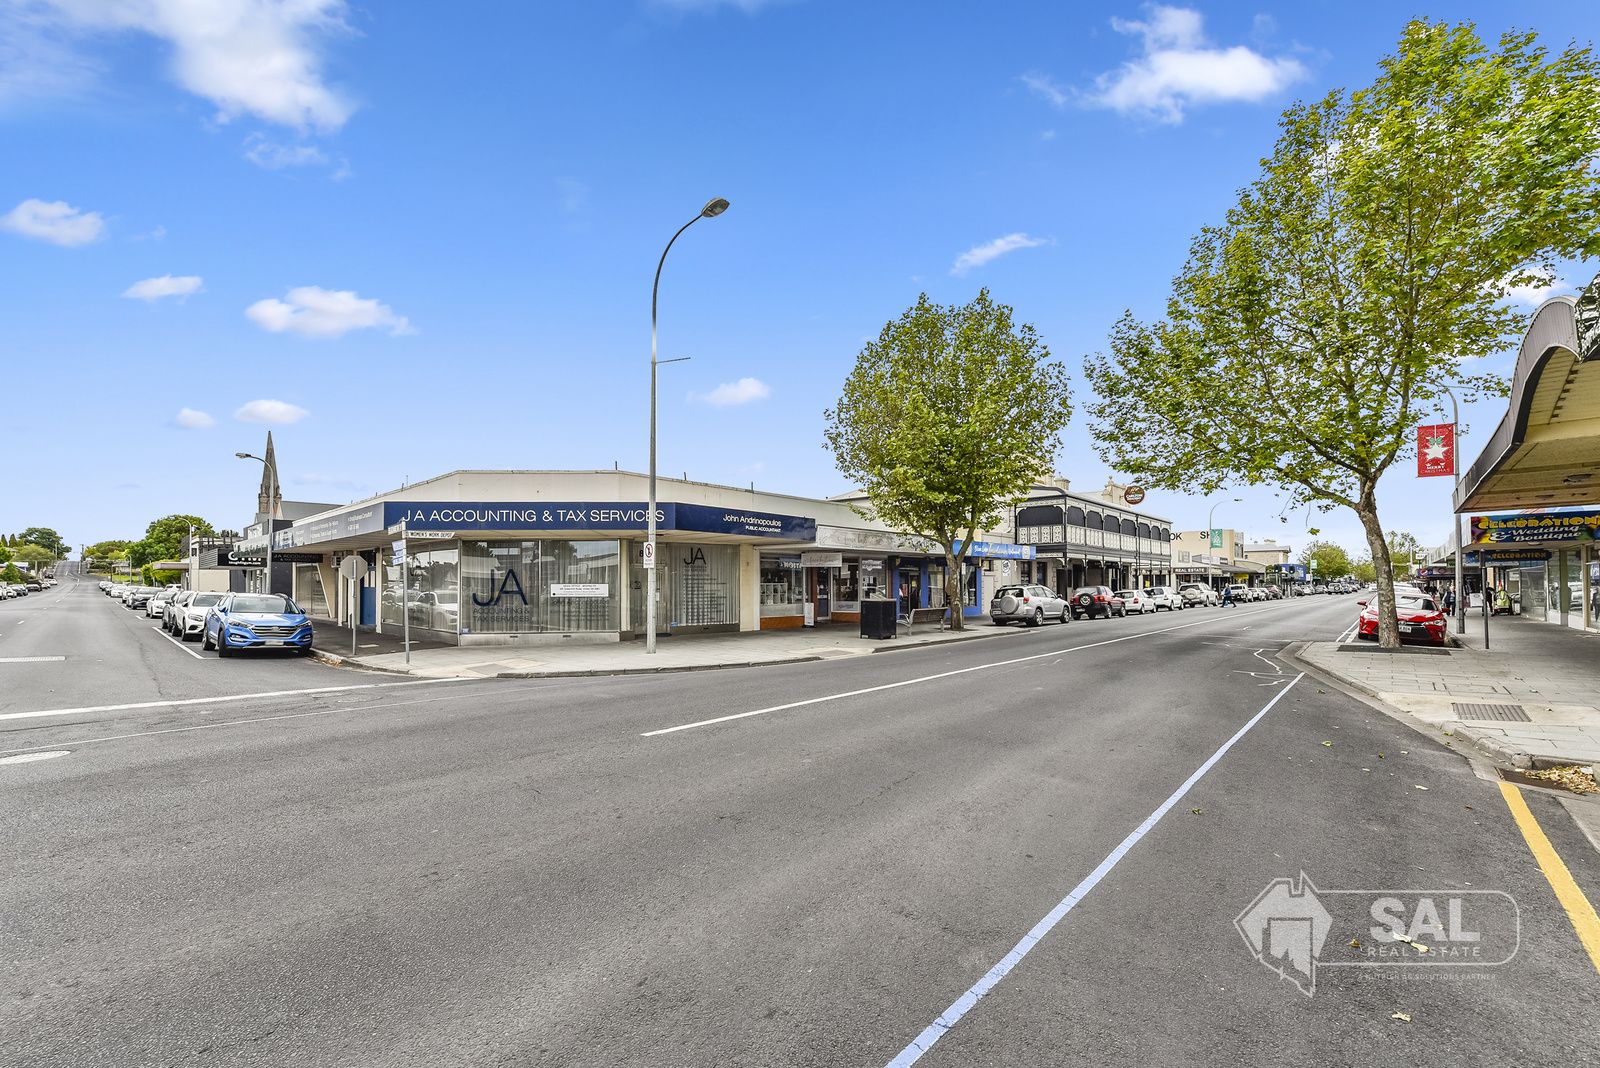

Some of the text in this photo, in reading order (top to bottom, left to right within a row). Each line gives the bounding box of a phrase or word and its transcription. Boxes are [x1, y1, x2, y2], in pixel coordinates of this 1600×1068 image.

[403, 509, 411, 522] J
[413, 509, 426, 522] A
[429, 509, 537, 522] ACCOUNTING
[542, 509, 553, 522] &
[556, 509, 587, 522] TAX
[723, 514, 782, 527] John Andrinopoulos
[1478, 515, 1600, 529] CELEBRATION
[1489, 525, 1580, 541] & Wedding
[1513, 532, 1582, 542] Boutique
[683, 547, 706, 565] JA
[472, 568, 528, 606] JA
[472, 607, 523, 615] ACCOUNTING
[473, 615, 489, 623] TAX
